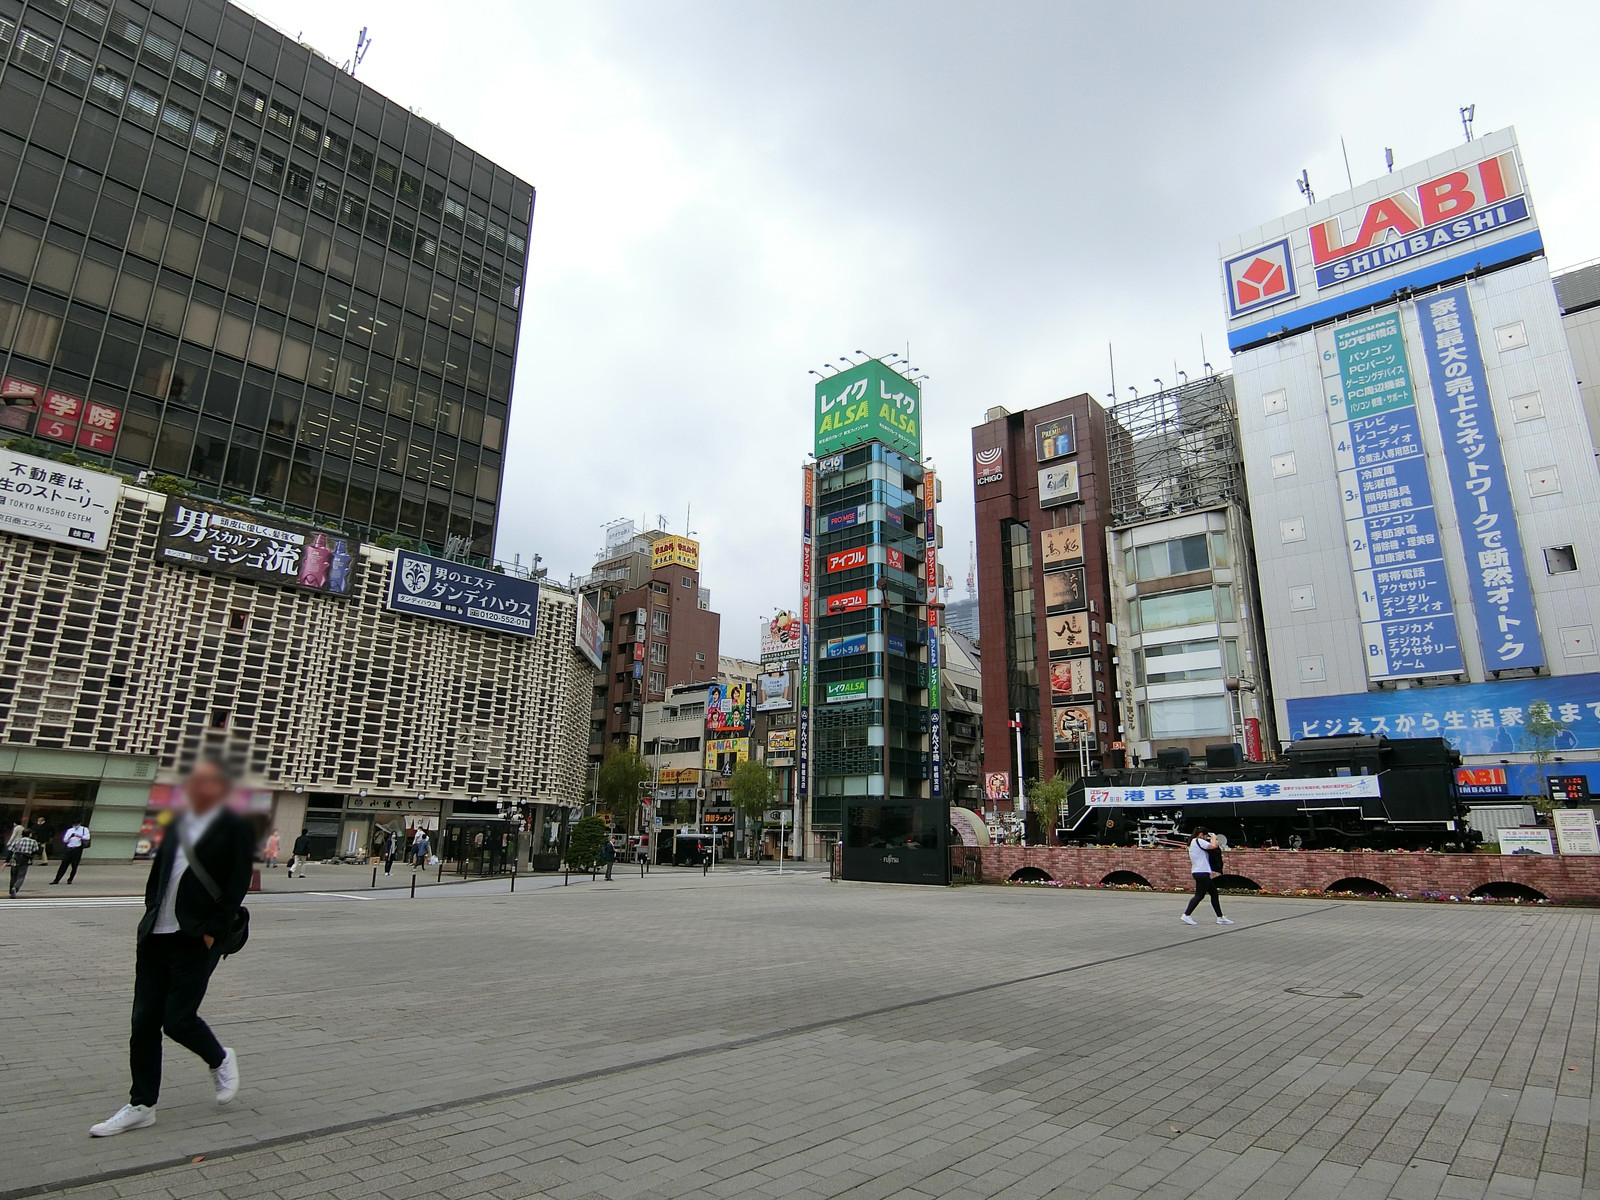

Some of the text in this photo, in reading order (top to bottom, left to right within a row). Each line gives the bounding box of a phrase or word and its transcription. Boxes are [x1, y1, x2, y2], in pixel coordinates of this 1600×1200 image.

[1309, 154, 1512, 265] LABI
[1333, 207, 1508, 279] SHIMBASHI
[1338, 319, 1396, 339] TSUKUMO
[1339, 325, 1398, 350] ツクモ新橋店
[1323, 350, 1336, 361] 6F
[1349, 344, 1393, 363] パソコン
[1349, 355, 1395, 375] PCパーツ
[1346, 365, 1404, 388] ゲーミングデバイス
[821, 378, 868, 414] レイク
[880, 379, 915, 414] レイク
[1347, 377, 1406, 400] PC周辺機器
[1330, 395, 1344, 406] 5F
[818, 400, 869, 434] ALSA
[878, 403, 917, 437] ALSA
[1353, 415, 1386, 432] テレビ
[1355, 424, 1411, 443] レコーダー
[1337, 441, 1351, 452] 4F
[1357, 434, 1412, 453] オーディオ
[1358, 444, 1418, 465] 企業法人専用窓口
[820, 456, 840, 471] K-16
[9, 461, 91, 493] 不動産は、
[977, 472, 1003, 486] ICHIGO
[1361, 465, 1395, 480] 冷蔵庫
[1362, 477, 1397, 491] 洗濯機
[0, 478, 110, 515] 生のストーリー。
[1345, 490, 1359, 501] 3F
[1364, 486, 1411, 503] 照明器具
[9, 499, 92, 524] TOKYO NISSHO ESTEM
[1366, 497, 1413, 514] 調理家電
[170, 505, 211, 543] 男
[831, 512, 855, 525] PROMISE
[1369, 514, 1415, 529] エアコン
[207, 527, 262, 549] スカルプ
[1371, 524, 1418, 540] 季節家電
[1352, 540, 1367, 551] 2F
[830, 551, 865, 569] アイフル
[888, 558, 902, 569] アイフル
[1374, 549, 1416, 565] 健康家電
[434, 566, 496, 590] 男のエステ
[1377, 567, 1425, 583] 携帯電話
[1379, 579, 1437, 594] アクセサリー
[399, 595, 438, 608] ダンディハウス
[431, 582, 532, 617] ダンディハウス
[1361, 591, 1375, 602] 1F
[1382, 593, 1429, 607] デジタル
[1384, 601, 1443, 617] オーディオ
[1387, 622, 1434, 636] デジカメ
[1389, 635, 1432, 648] デジカメ
[831, 645, 860, 657] セントラル
[1369, 644, 1384, 656] B1
[1390, 643, 1456, 658] アクセサリー
[1392, 659, 1425, 670] ゲーム
[829, 682, 865, 694] レイクALSA
[717, 739, 738, 750] MAP
[1457, 768, 1507, 786] ABI
[1124, 783, 1281, 802] 港区長選挙
[1459, 785, 1503, 794] IMBASHI
[883, 854, 900, 864] FUJITSU
